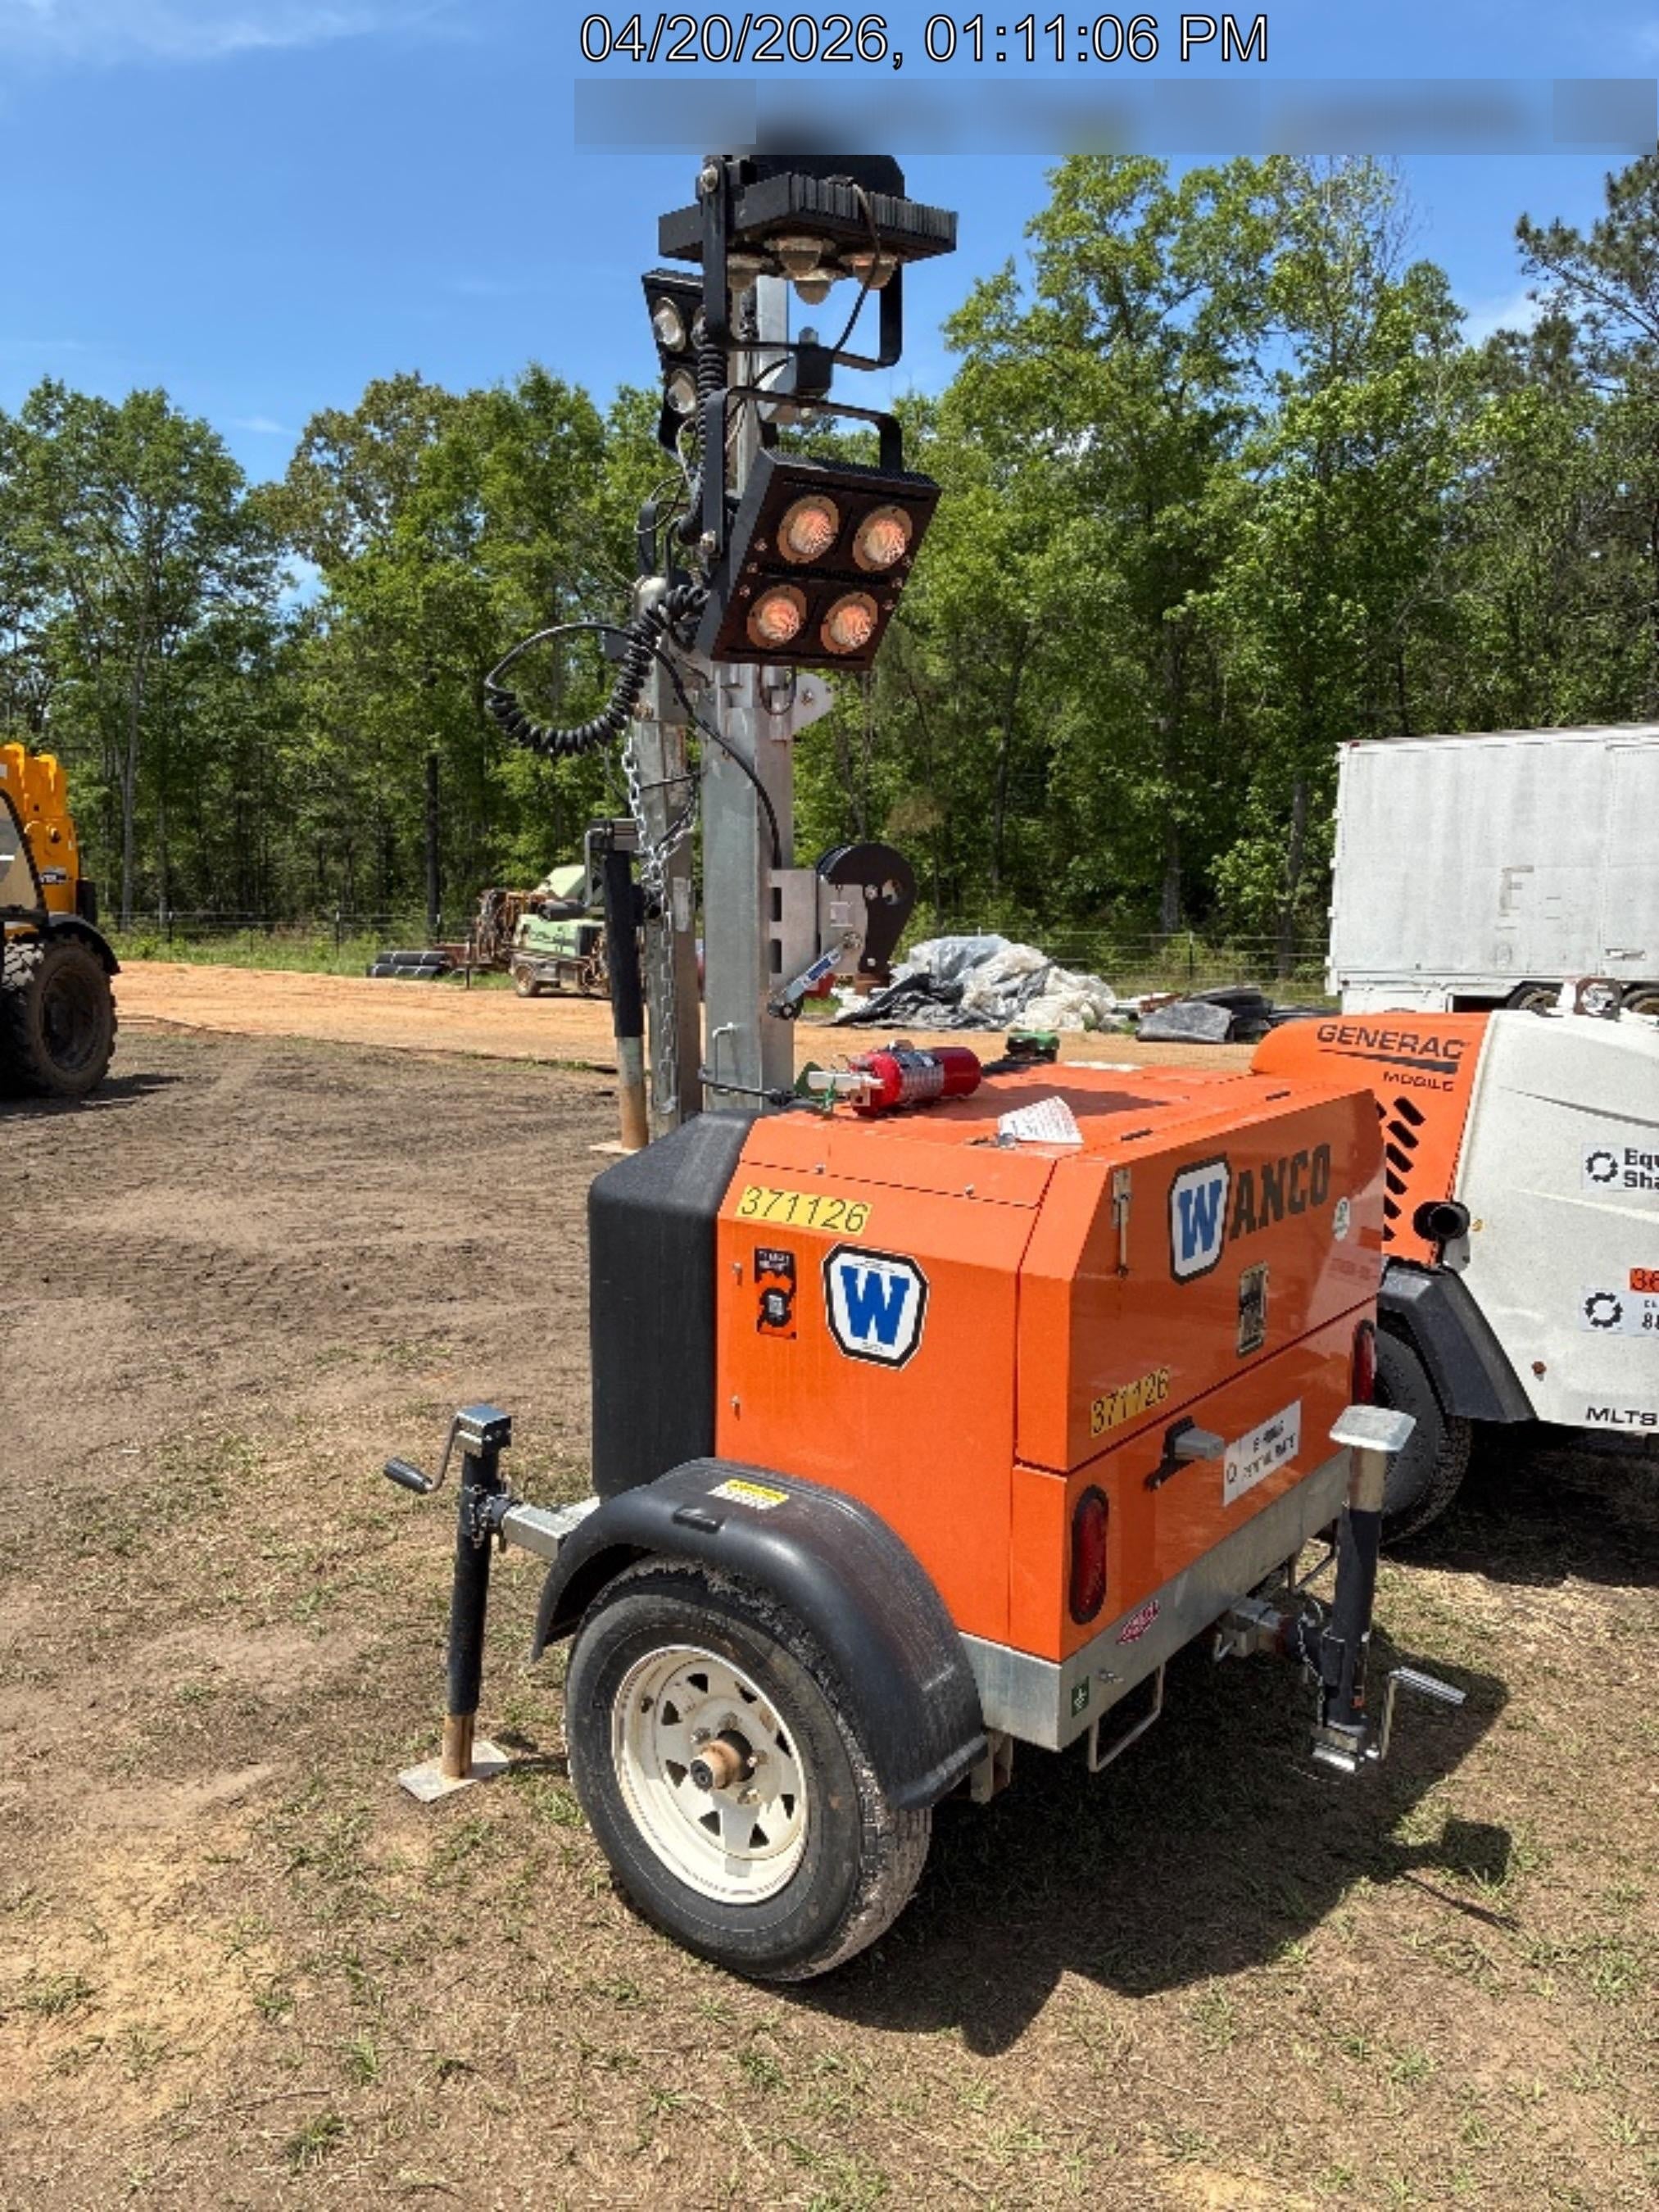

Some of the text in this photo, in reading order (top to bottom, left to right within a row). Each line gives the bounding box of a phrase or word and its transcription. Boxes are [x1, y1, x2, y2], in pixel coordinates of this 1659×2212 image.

[1317, 1025, 1463, 1059] GENERAC
[1383, 1072, 1454, 1091] MOBILE
[741, 1187, 868, 1231] 371126
[1179, 1144, 1330, 1262] WANCO
[840, 1265, 909, 1347] W
[1093, 1367, 1168, 1434] 371126
